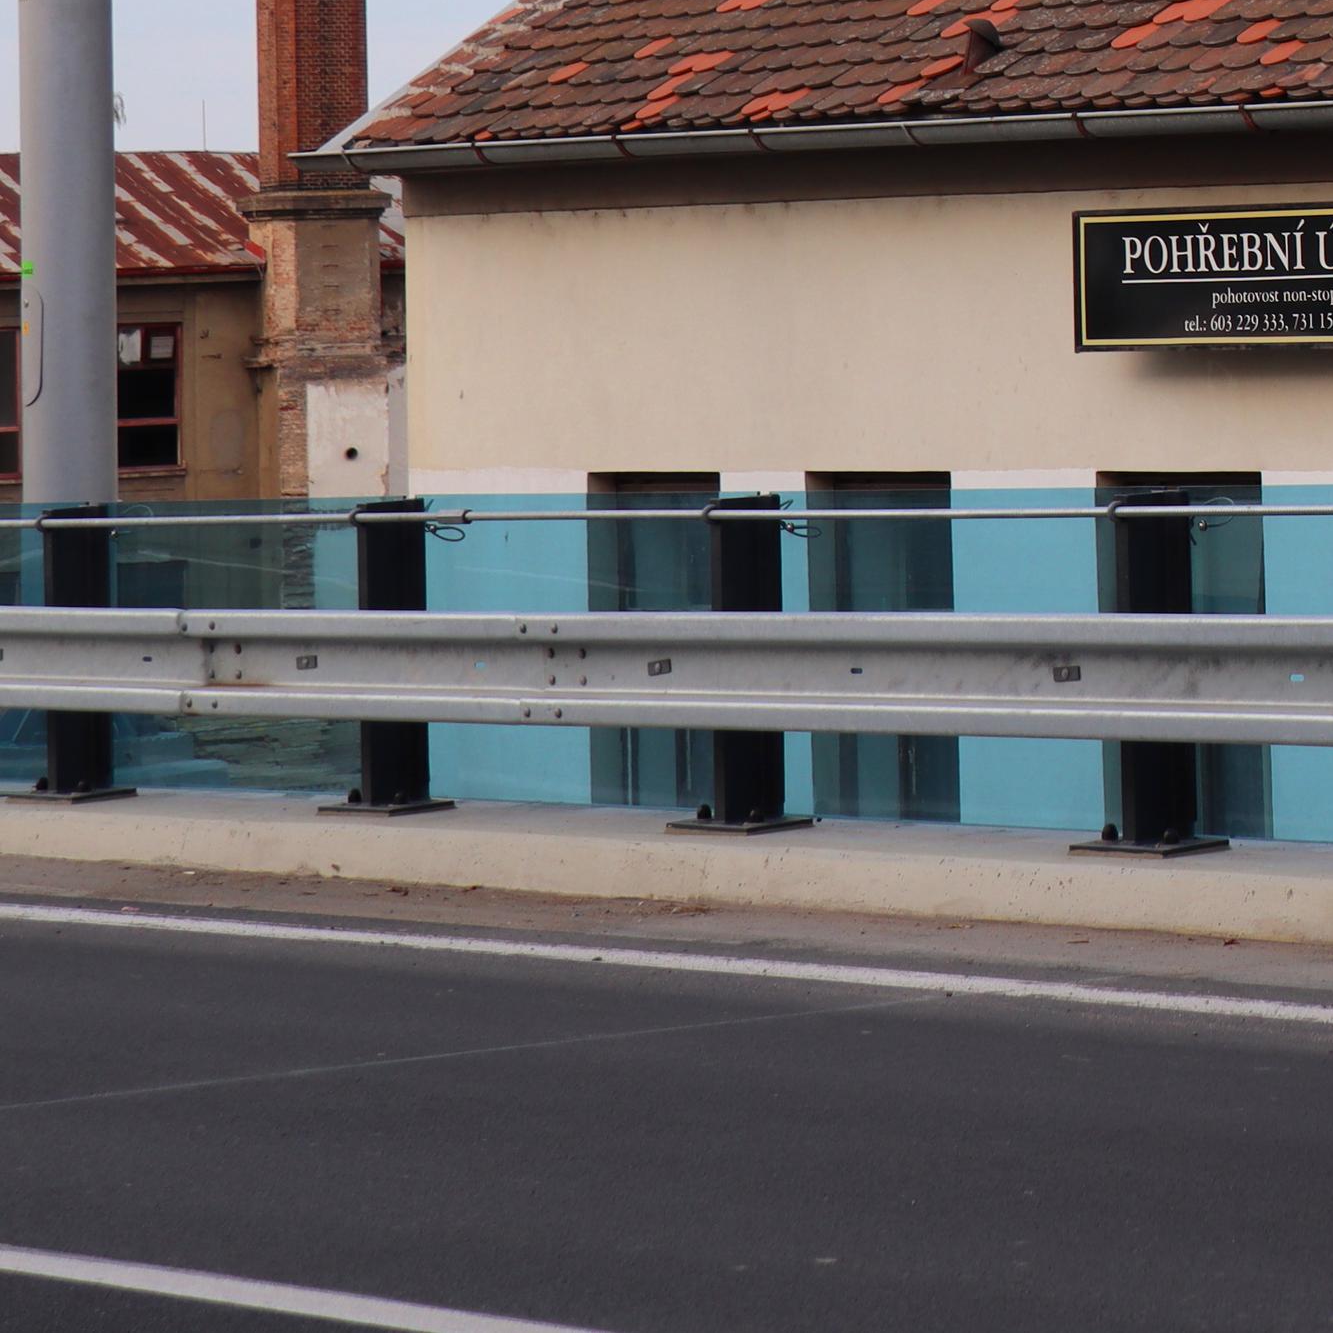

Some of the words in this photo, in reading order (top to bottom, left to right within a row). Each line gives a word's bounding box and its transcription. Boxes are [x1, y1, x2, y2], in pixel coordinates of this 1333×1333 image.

[1121, 219, 1305, 274] POHŘEBNÍ
[1211, 287, 1280, 309] pohotovost
[1183, 314, 1207, 332] tel.:
[1210, 313, 1233, 333] 603
[1236, 313, 1259, 332] 229
[1262, 313, 1290, 332] 333,
[1292, 313, 1315, 331] 731
